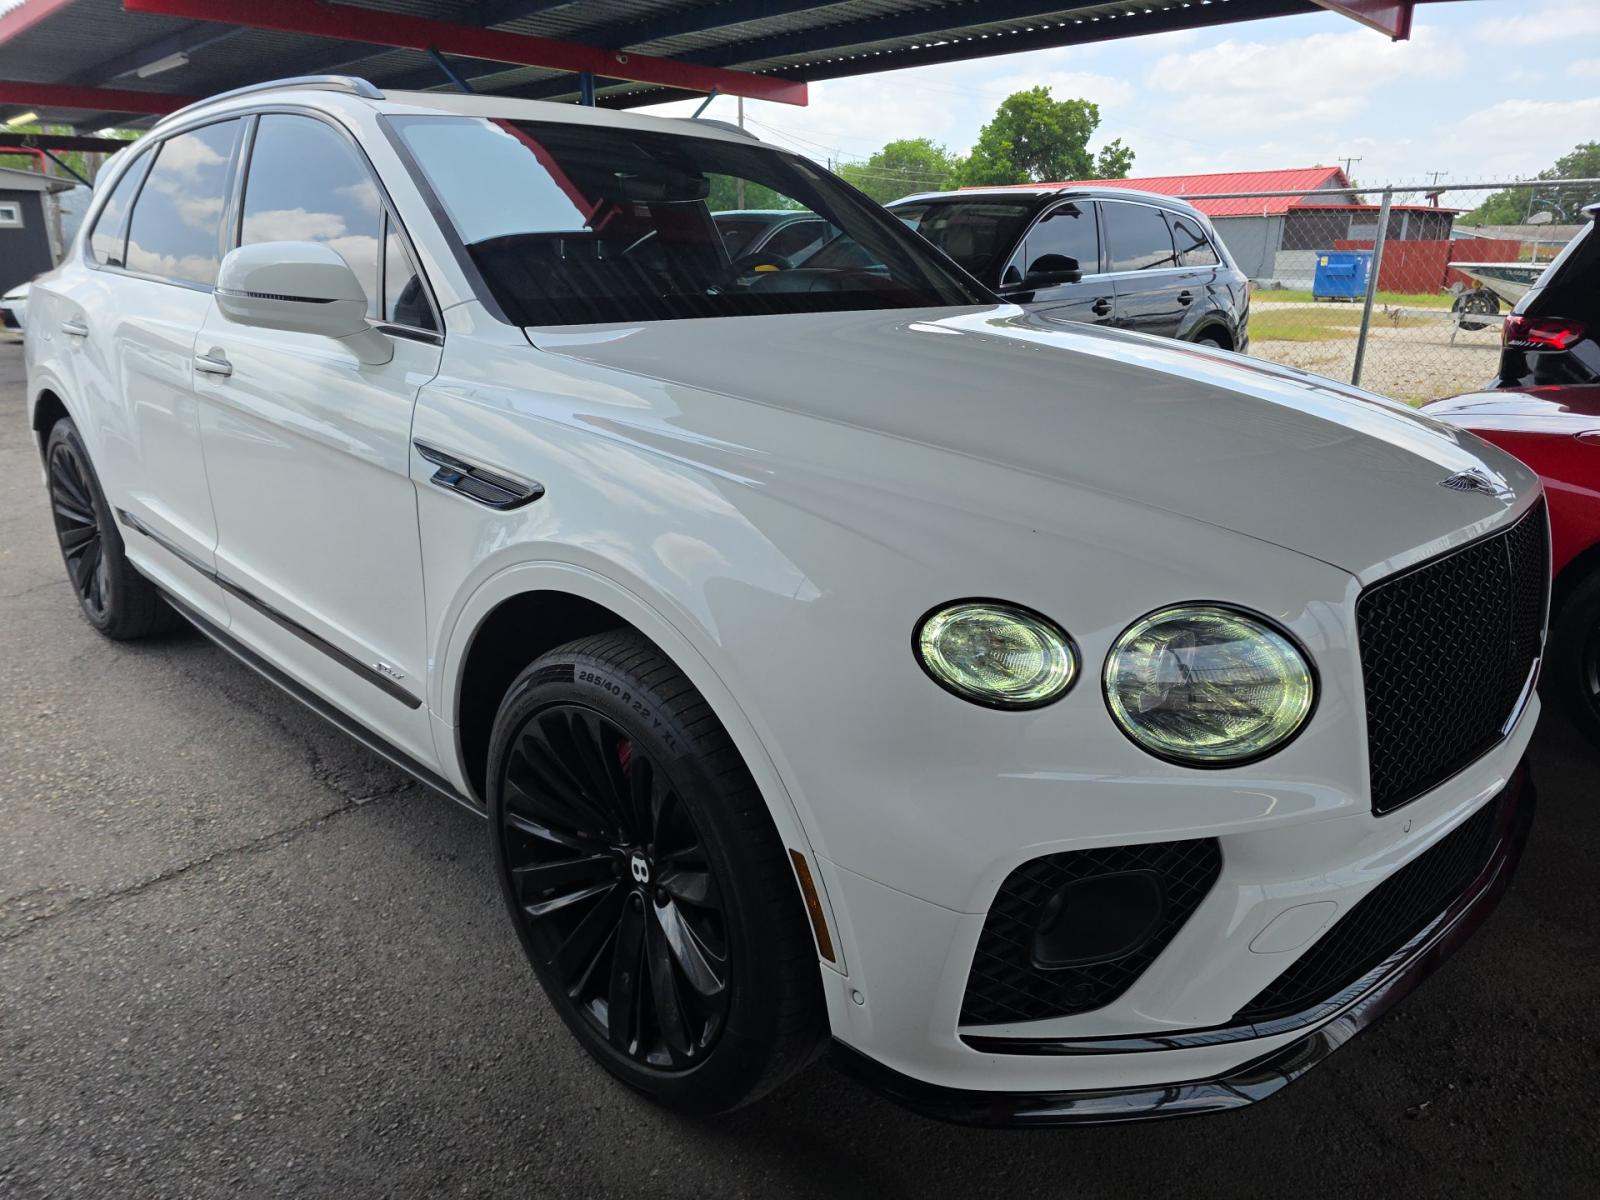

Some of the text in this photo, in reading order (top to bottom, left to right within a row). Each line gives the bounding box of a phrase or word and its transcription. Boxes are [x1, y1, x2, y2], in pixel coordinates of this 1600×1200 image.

[578, 671, 621, 697] 285/40
[622, 692, 632, 704] R
[632, 701, 651, 720] 22
[631, 855, 650, 883] B
